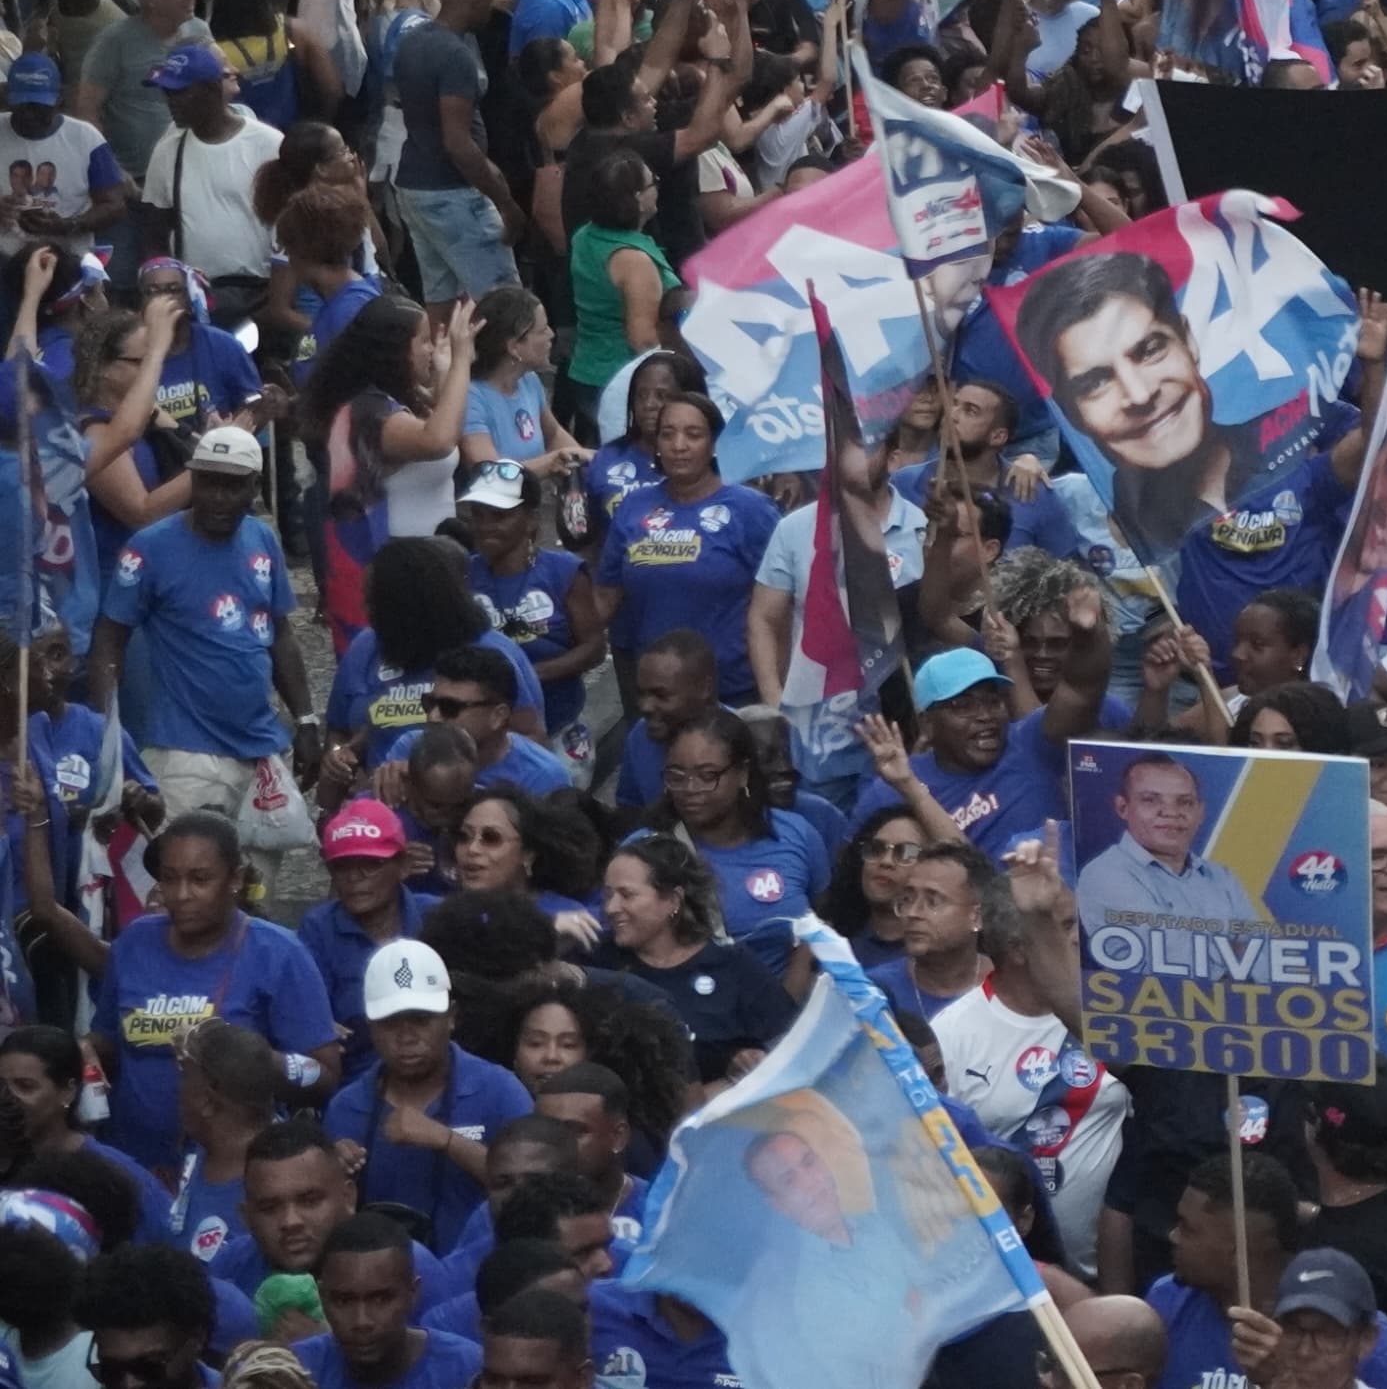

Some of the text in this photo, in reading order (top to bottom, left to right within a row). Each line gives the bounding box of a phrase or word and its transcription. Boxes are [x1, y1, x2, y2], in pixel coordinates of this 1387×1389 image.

[330, 822, 381, 843] NETO
[1296, 855, 1337, 881] 44
[753, 872, 781, 900] 44
[1104, 909, 1343, 940] DEPUTADO ESTADUAL
[1090, 926, 1363, 987] OLIVER
[1087, 972, 1370, 1033] SANTOS
[1023, 1050, 1053, 1072] 44
[1087, 1016, 1373, 1082] 33600
[1241, 1118, 1265, 1142] 44
